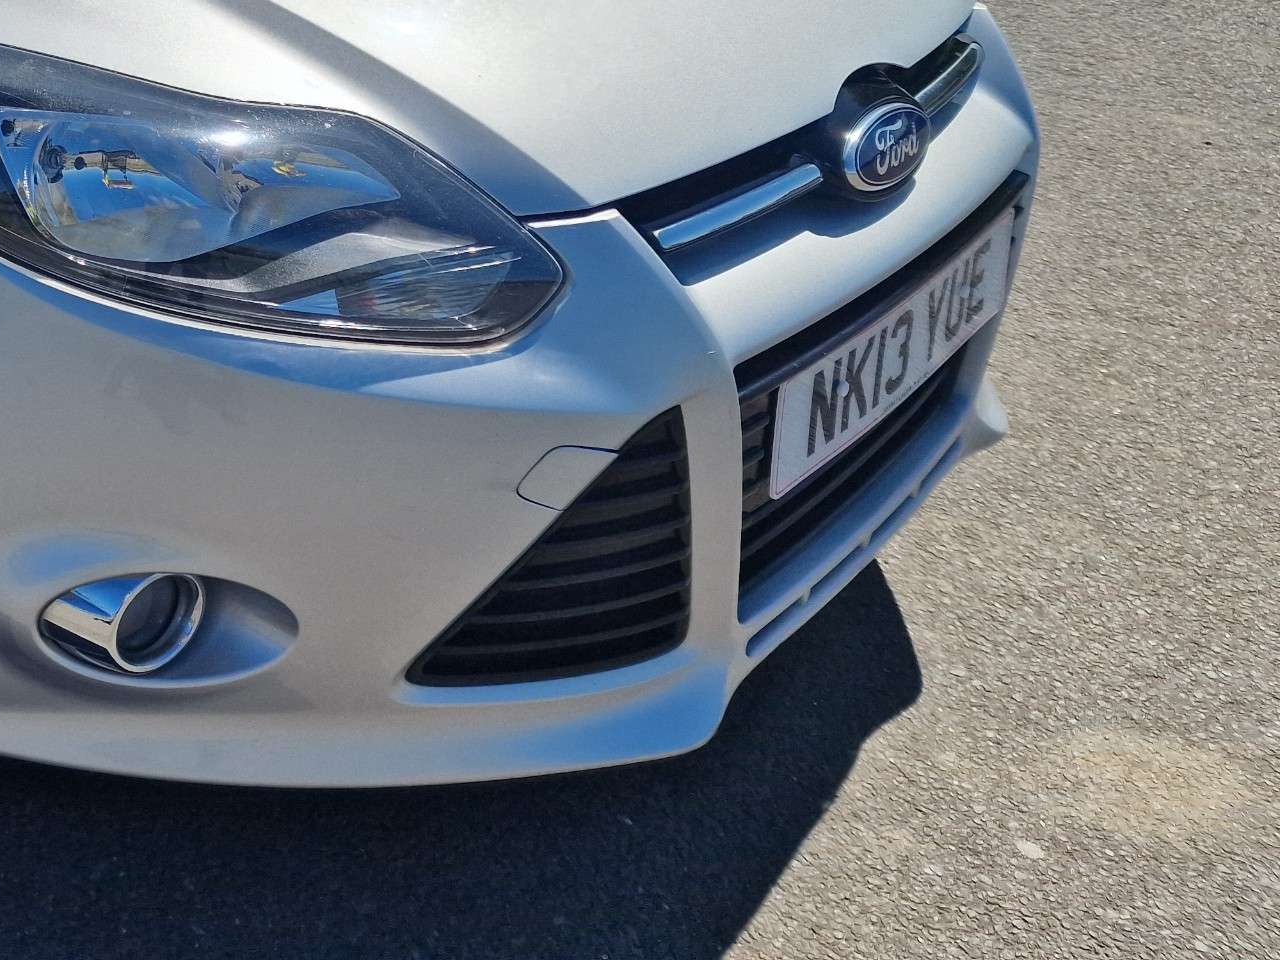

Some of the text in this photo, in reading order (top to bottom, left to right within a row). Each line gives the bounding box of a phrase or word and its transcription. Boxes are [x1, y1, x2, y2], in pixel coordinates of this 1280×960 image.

[875, 119, 920, 176] Ford
[806, 239, 992, 458] NK13 YUE
